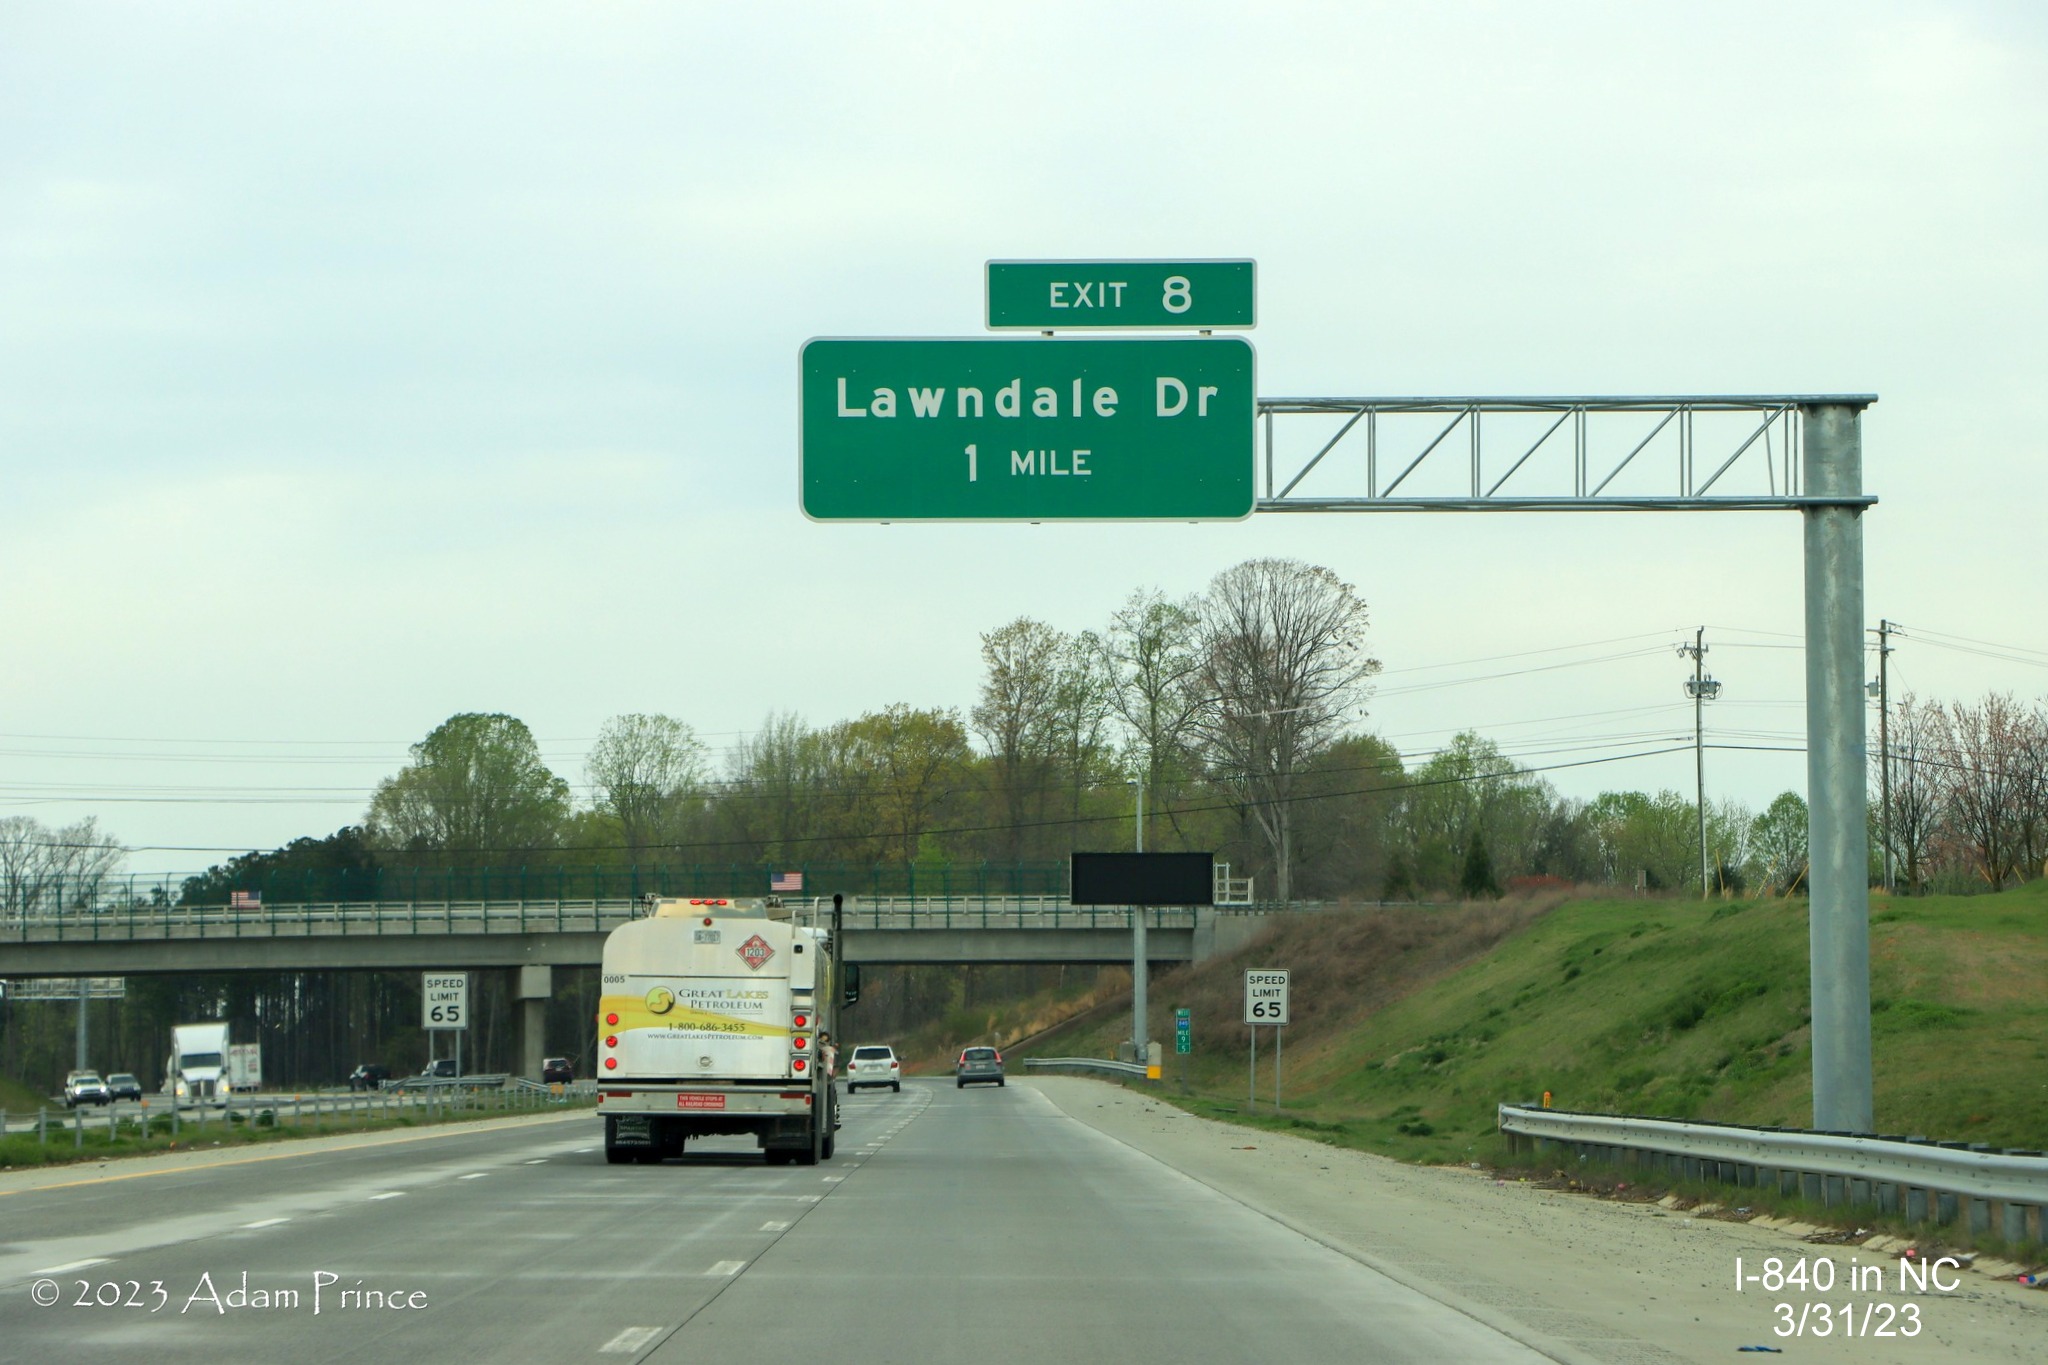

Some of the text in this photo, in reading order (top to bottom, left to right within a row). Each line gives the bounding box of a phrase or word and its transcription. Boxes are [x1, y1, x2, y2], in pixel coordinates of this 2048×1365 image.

[1050, 276, 1193, 314] EXIT 8
[837, 377, 1218, 418] Lawndale Dr
[964, 443, 1092, 482] 1 MILE
[747, 948, 765, 957] 1203
[426, 979, 464, 988] SPEED
[604, 975, 625, 984] 0005
[1249, 976, 1285, 984] SPEED
[430, 993, 459, 1001] LIMIT
[679, 988, 769, 999] GREAT LAKES
[1252, 989, 1281, 997] LIMIT
[690, 1000, 763, 1010] PETROLEUM
[1252, 1002, 1281, 1017] 65
[431, 1006, 460, 1022] 65
[668, 1022, 745, 1032] 1-800-686-3455
[1181, 1045, 1186, 1053] 5
